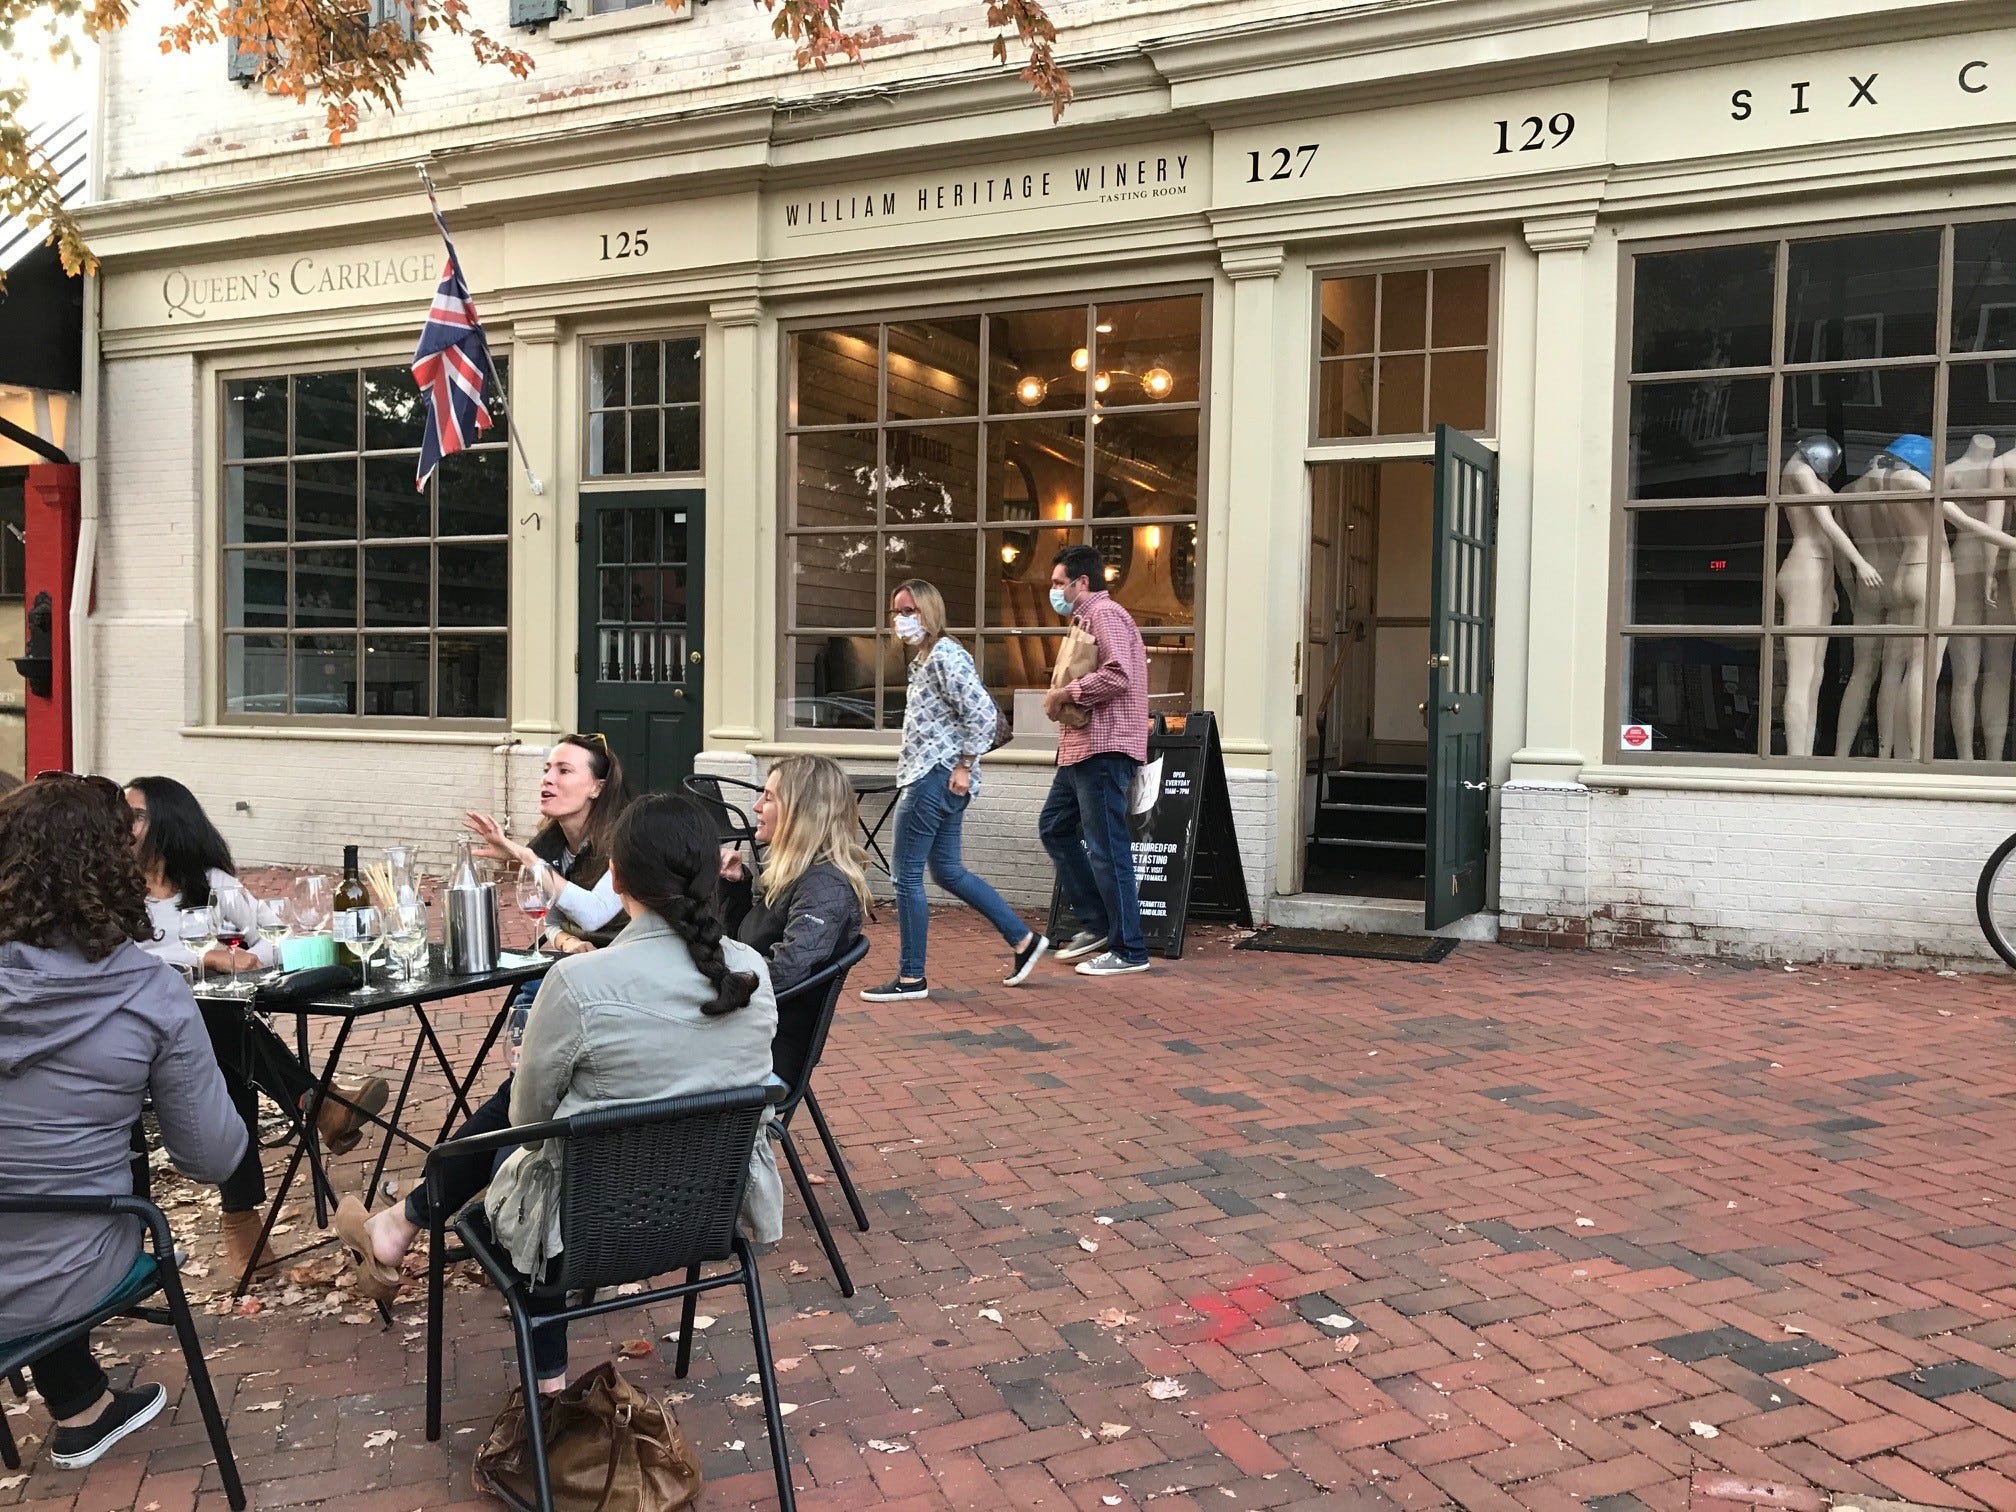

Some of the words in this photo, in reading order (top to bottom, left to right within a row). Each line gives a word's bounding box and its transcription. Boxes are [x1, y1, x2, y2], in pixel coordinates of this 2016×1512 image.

[1731, 73, 1879, 121] SIX
[1492, 112, 1575, 155] 129
[1246, 143, 1320, 184] 127
[786, 192, 895, 227] WILLIAM
[918, 172, 1050, 212] HERITAGE
[1075, 154, 1189, 192] WINERY
[1099, 190, 1148, 203] TASTING
[1152, 185, 1187, 198] ROOM
[599, 227, 649, 261] 125
[290, 253, 437, 296] CARRIAGE
[1165, 779, 1190, 787] EVERYDAY
[1130, 842, 1163, 853] REQUIRED
[1163, 843, 1178, 854] FOR
[1138, 854, 1169, 865] TASTING
